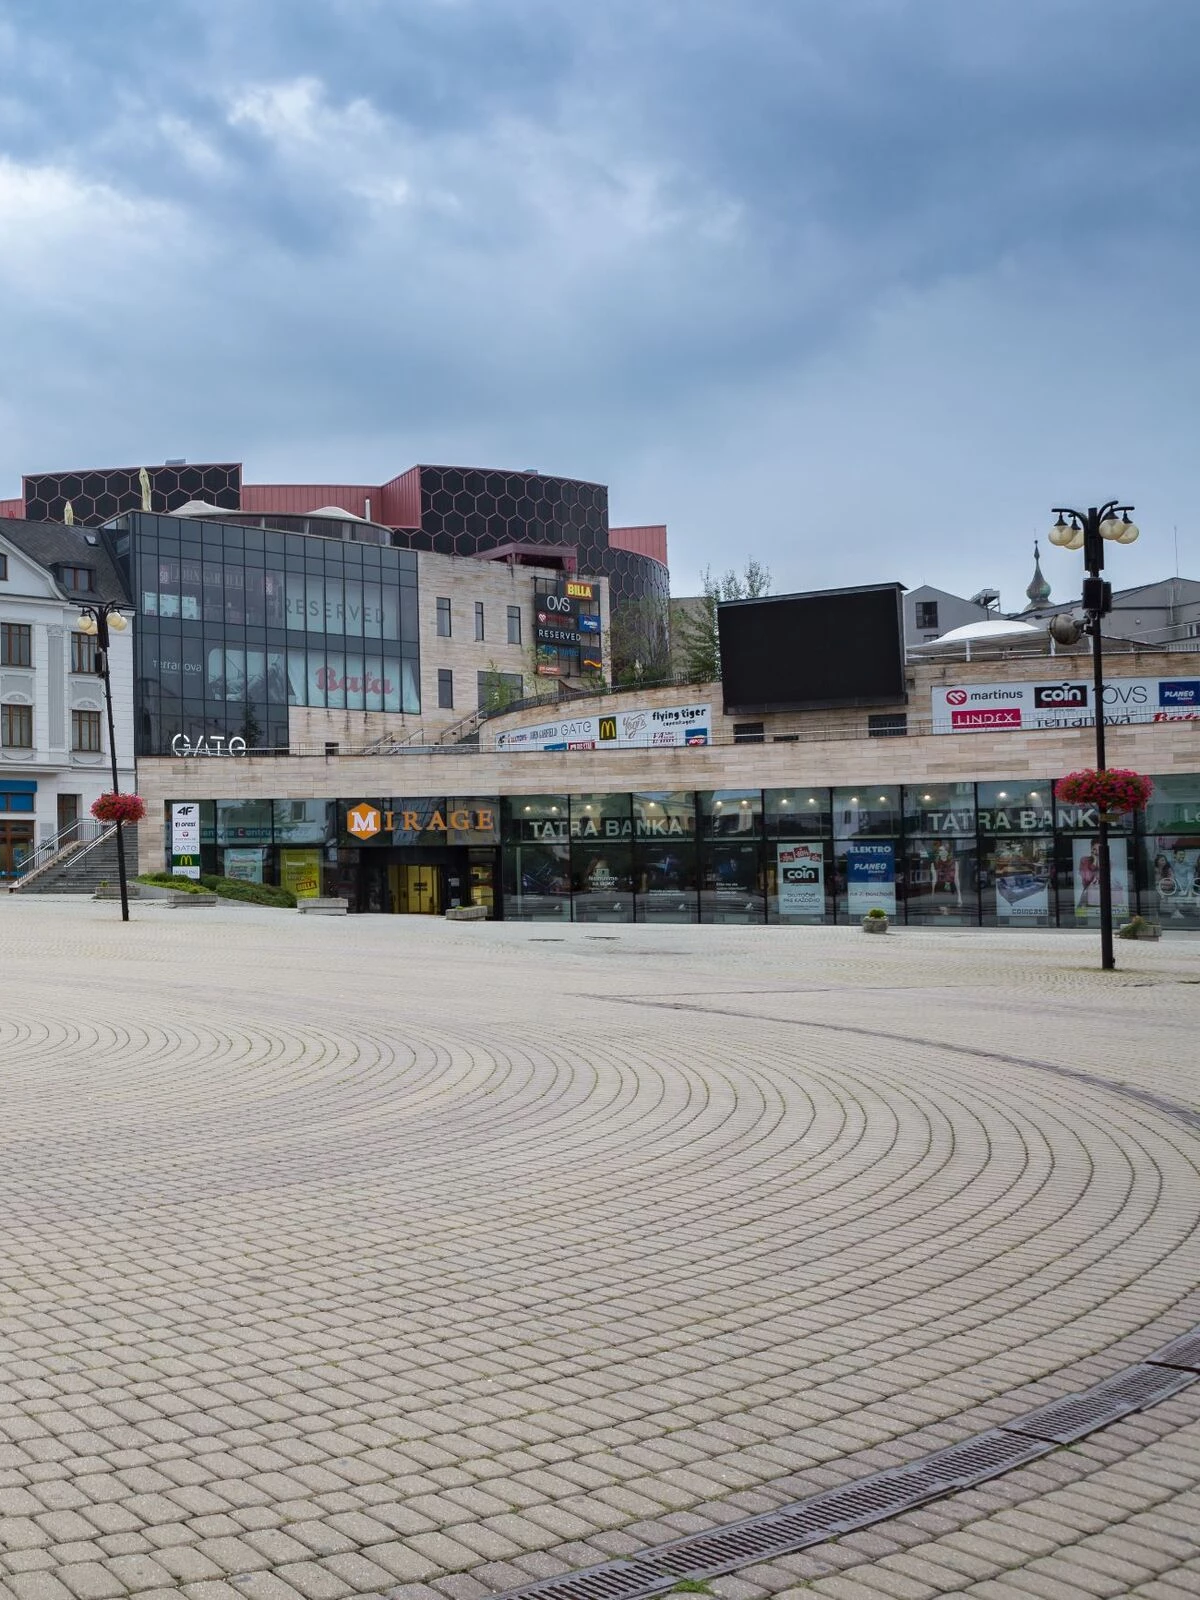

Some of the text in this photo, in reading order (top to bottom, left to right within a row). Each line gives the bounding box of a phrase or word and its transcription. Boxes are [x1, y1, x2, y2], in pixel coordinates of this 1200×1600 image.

[567, 583, 592, 598] BILLA
[546, 595, 571, 612] OVS
[285, 599, 385, 624] RESERVED
[538, 629, 582, 641] RESERVED
[970, 689, 1024, 701] martinus
[1040, 683, 1082, 702] coin
[1103, 686, 1148, 704] OVS
[1164, 690, 1195, 698] PLANEO
[652, 708, 706, 721] flying tiger
[956, 713, 1014, 726] LINDEX
[351, 808, 494, 832] MIRAGE
[928, 812, 1011, 831] TATRA
[529, 818, 684, 838] TATRA BANKA
[850, 846, 892, 854] ELEKTRO
[787, 865, 815, 879] coin
